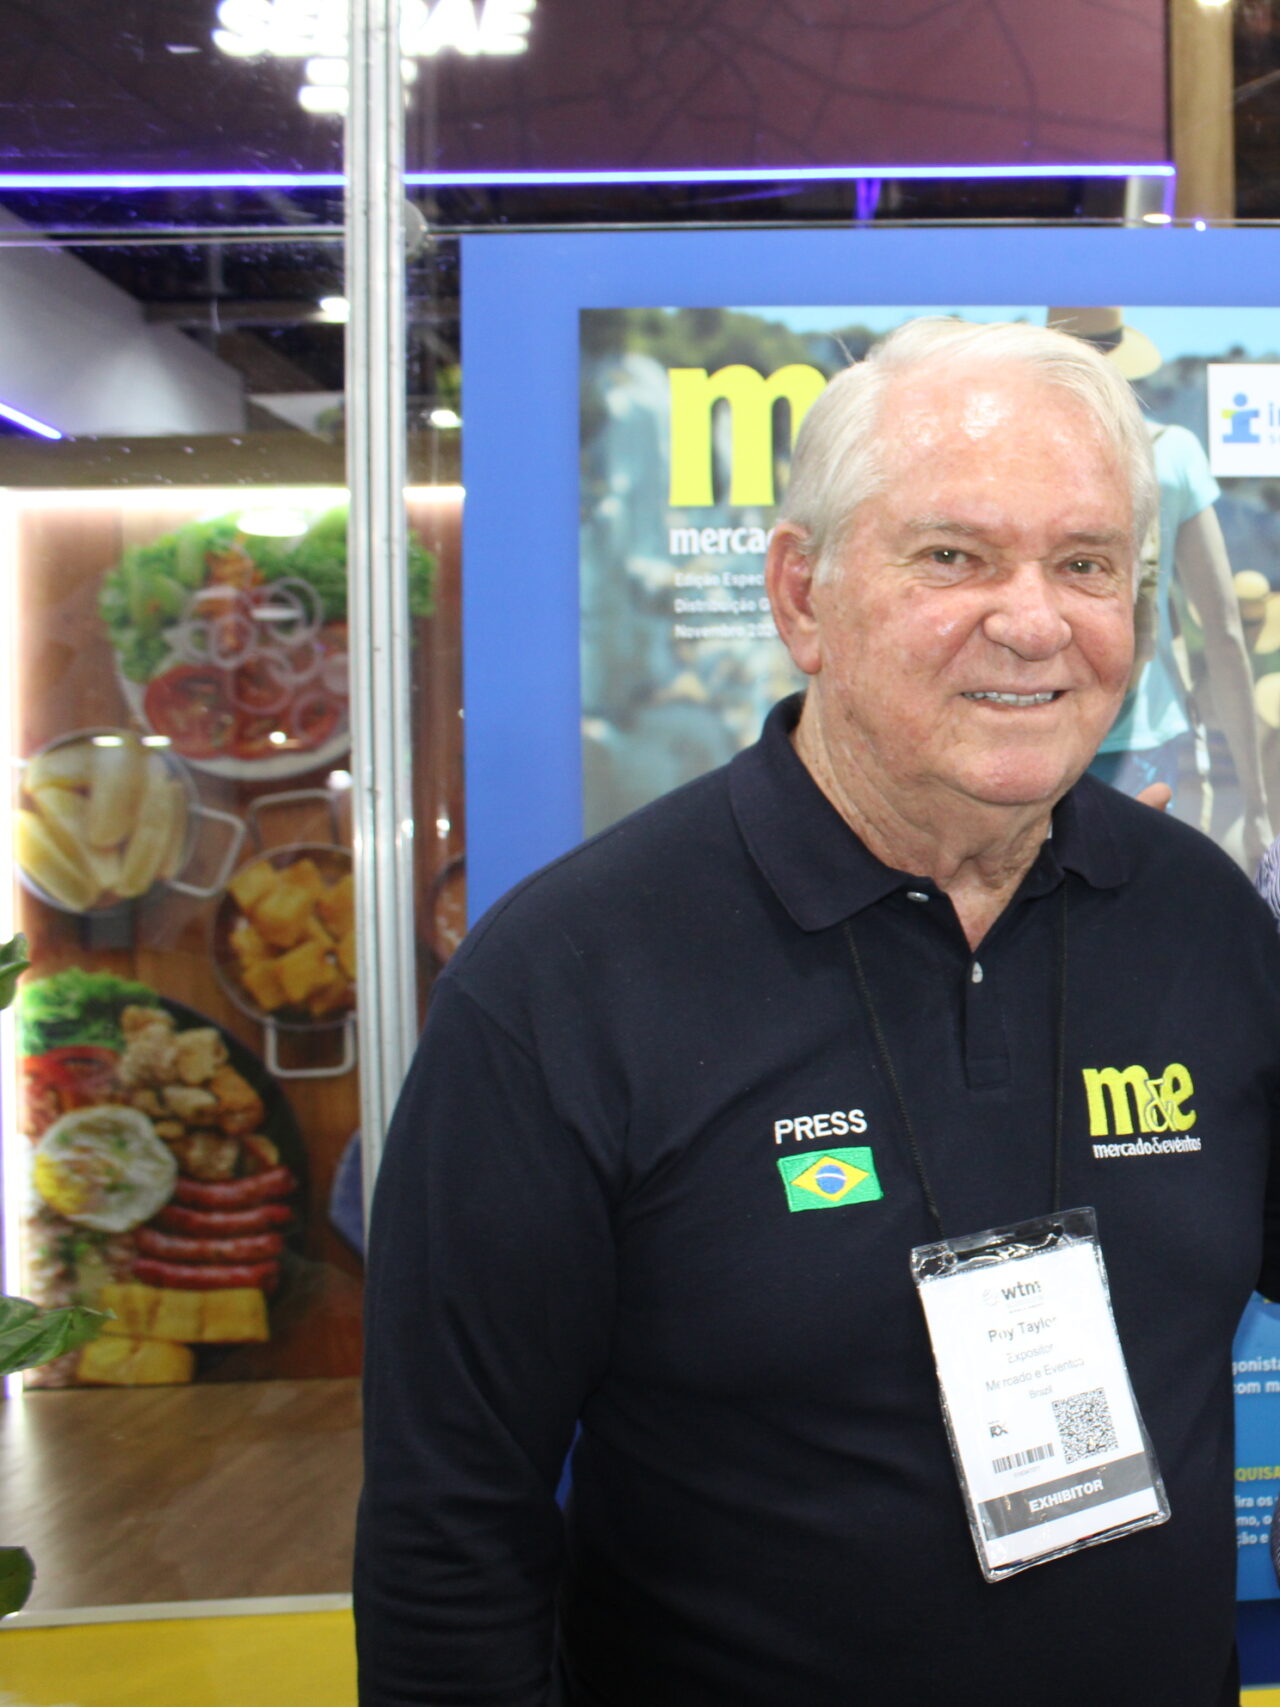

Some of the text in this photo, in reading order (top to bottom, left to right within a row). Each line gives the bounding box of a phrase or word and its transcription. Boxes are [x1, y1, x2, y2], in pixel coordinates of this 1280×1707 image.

[211, 0, 537, 57] SEAE
[669, 526, 775, 555] merca
[774, 1109, 868, 1144] PRESS
[1001, 1281, 1042, 1300] wtm
[1028, 1479, 1104, 1513] EXHIBITOR
